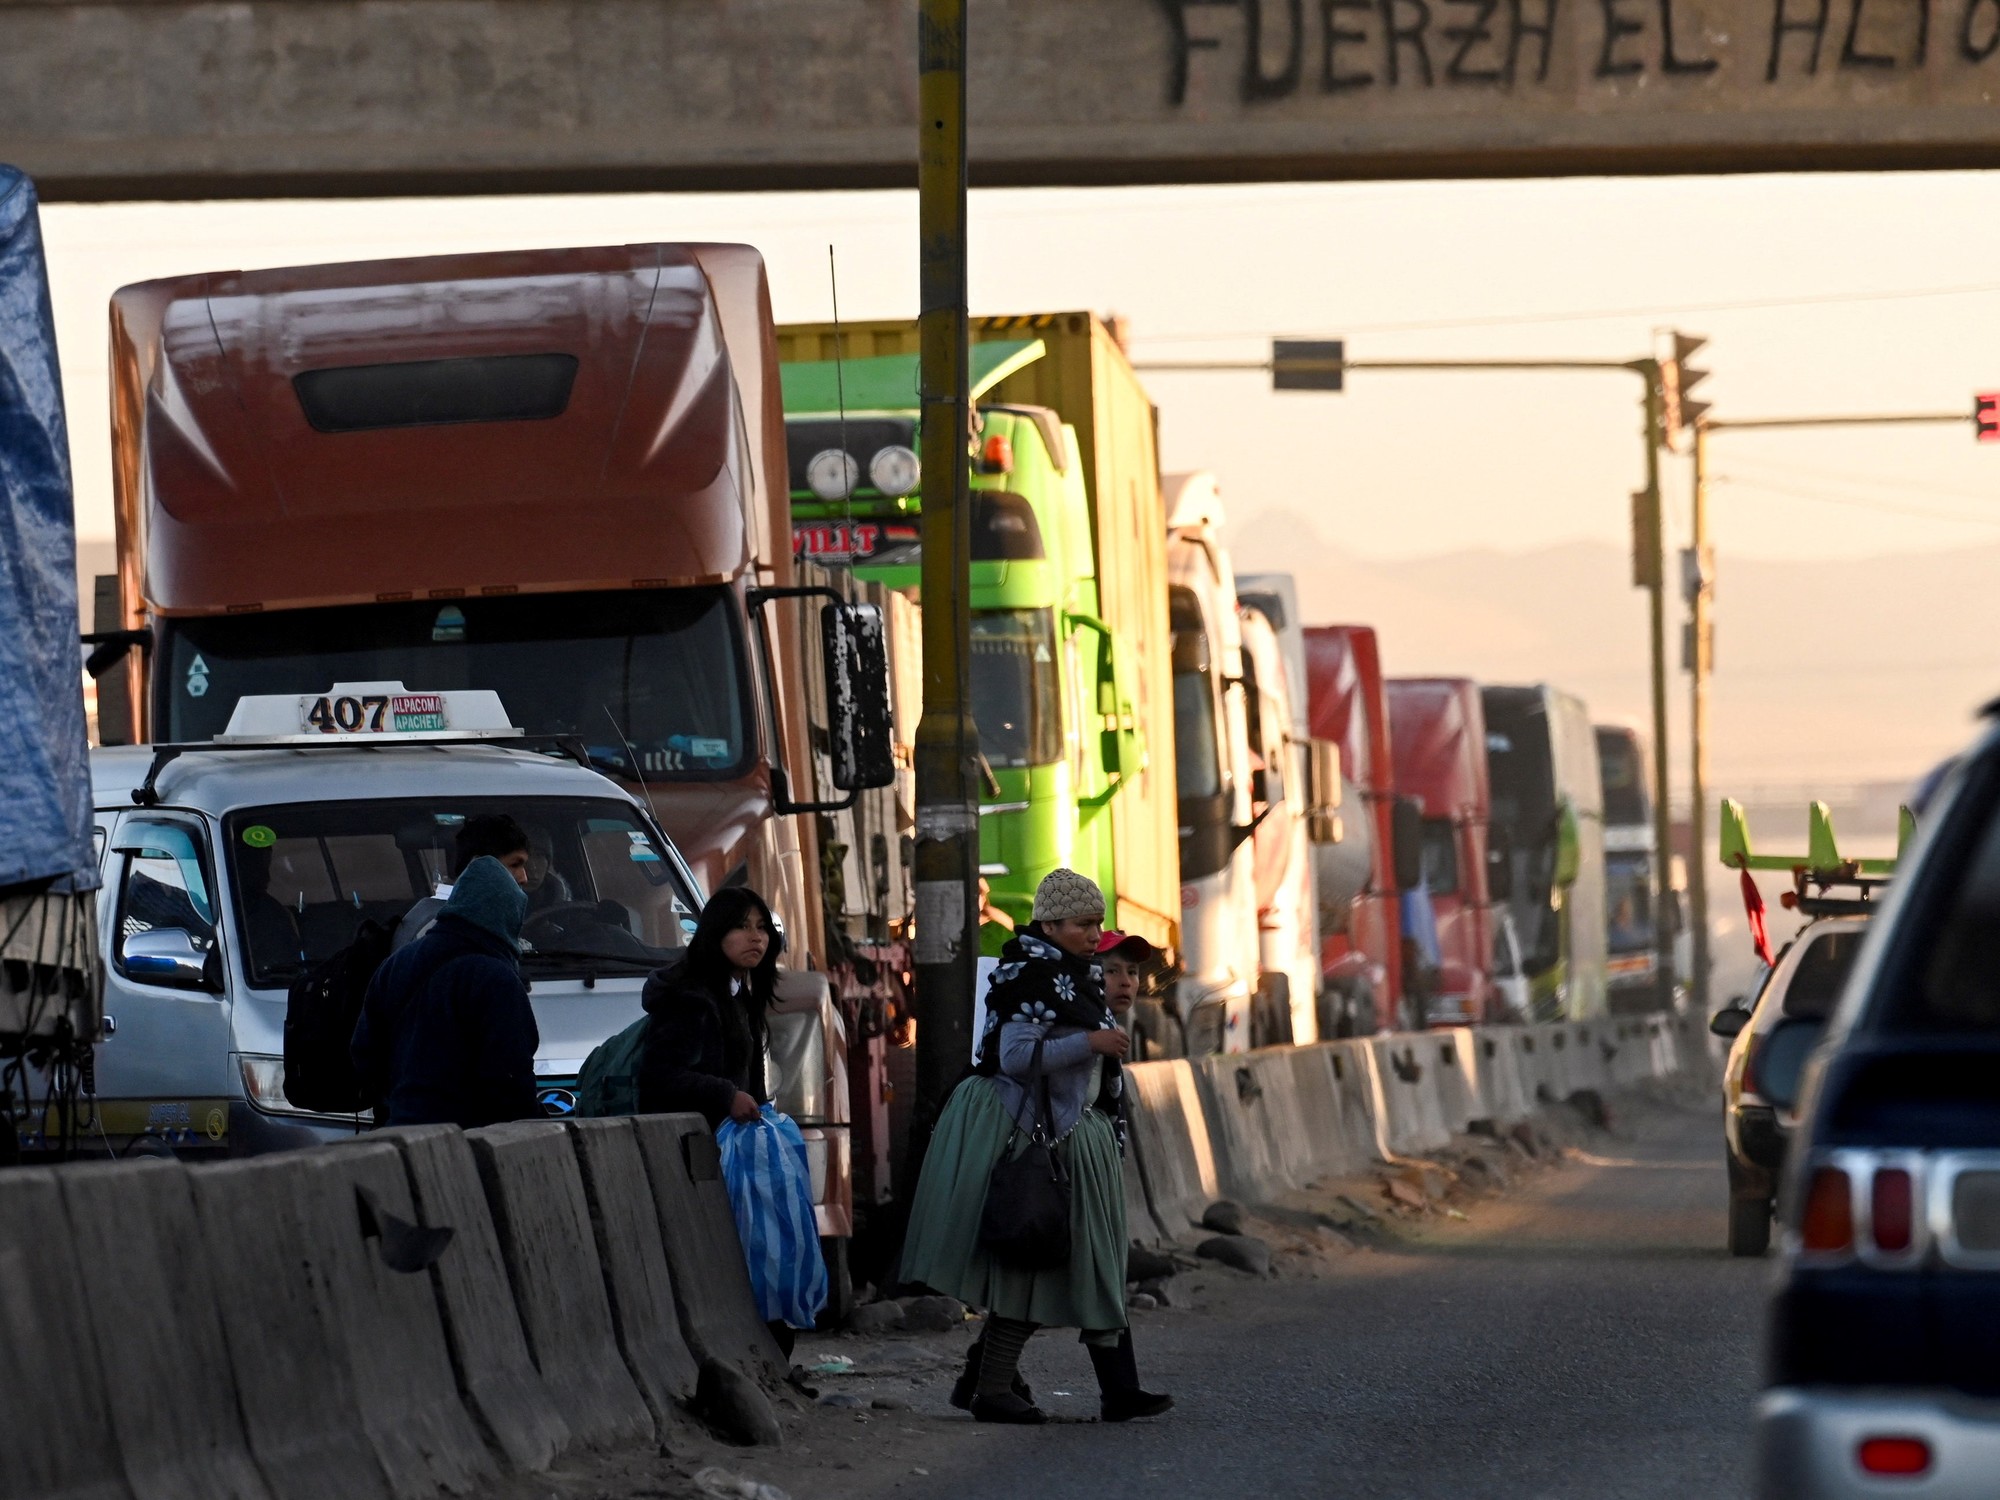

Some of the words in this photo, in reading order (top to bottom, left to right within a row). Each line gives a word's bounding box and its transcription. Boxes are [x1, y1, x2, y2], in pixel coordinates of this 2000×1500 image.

[1596, 0, 1718, 77] EL
[308, 696, 391, 733] 407
[393, 697, 442, 713] ALPACOMA
[396, 714, 443, 730] APACHETA
